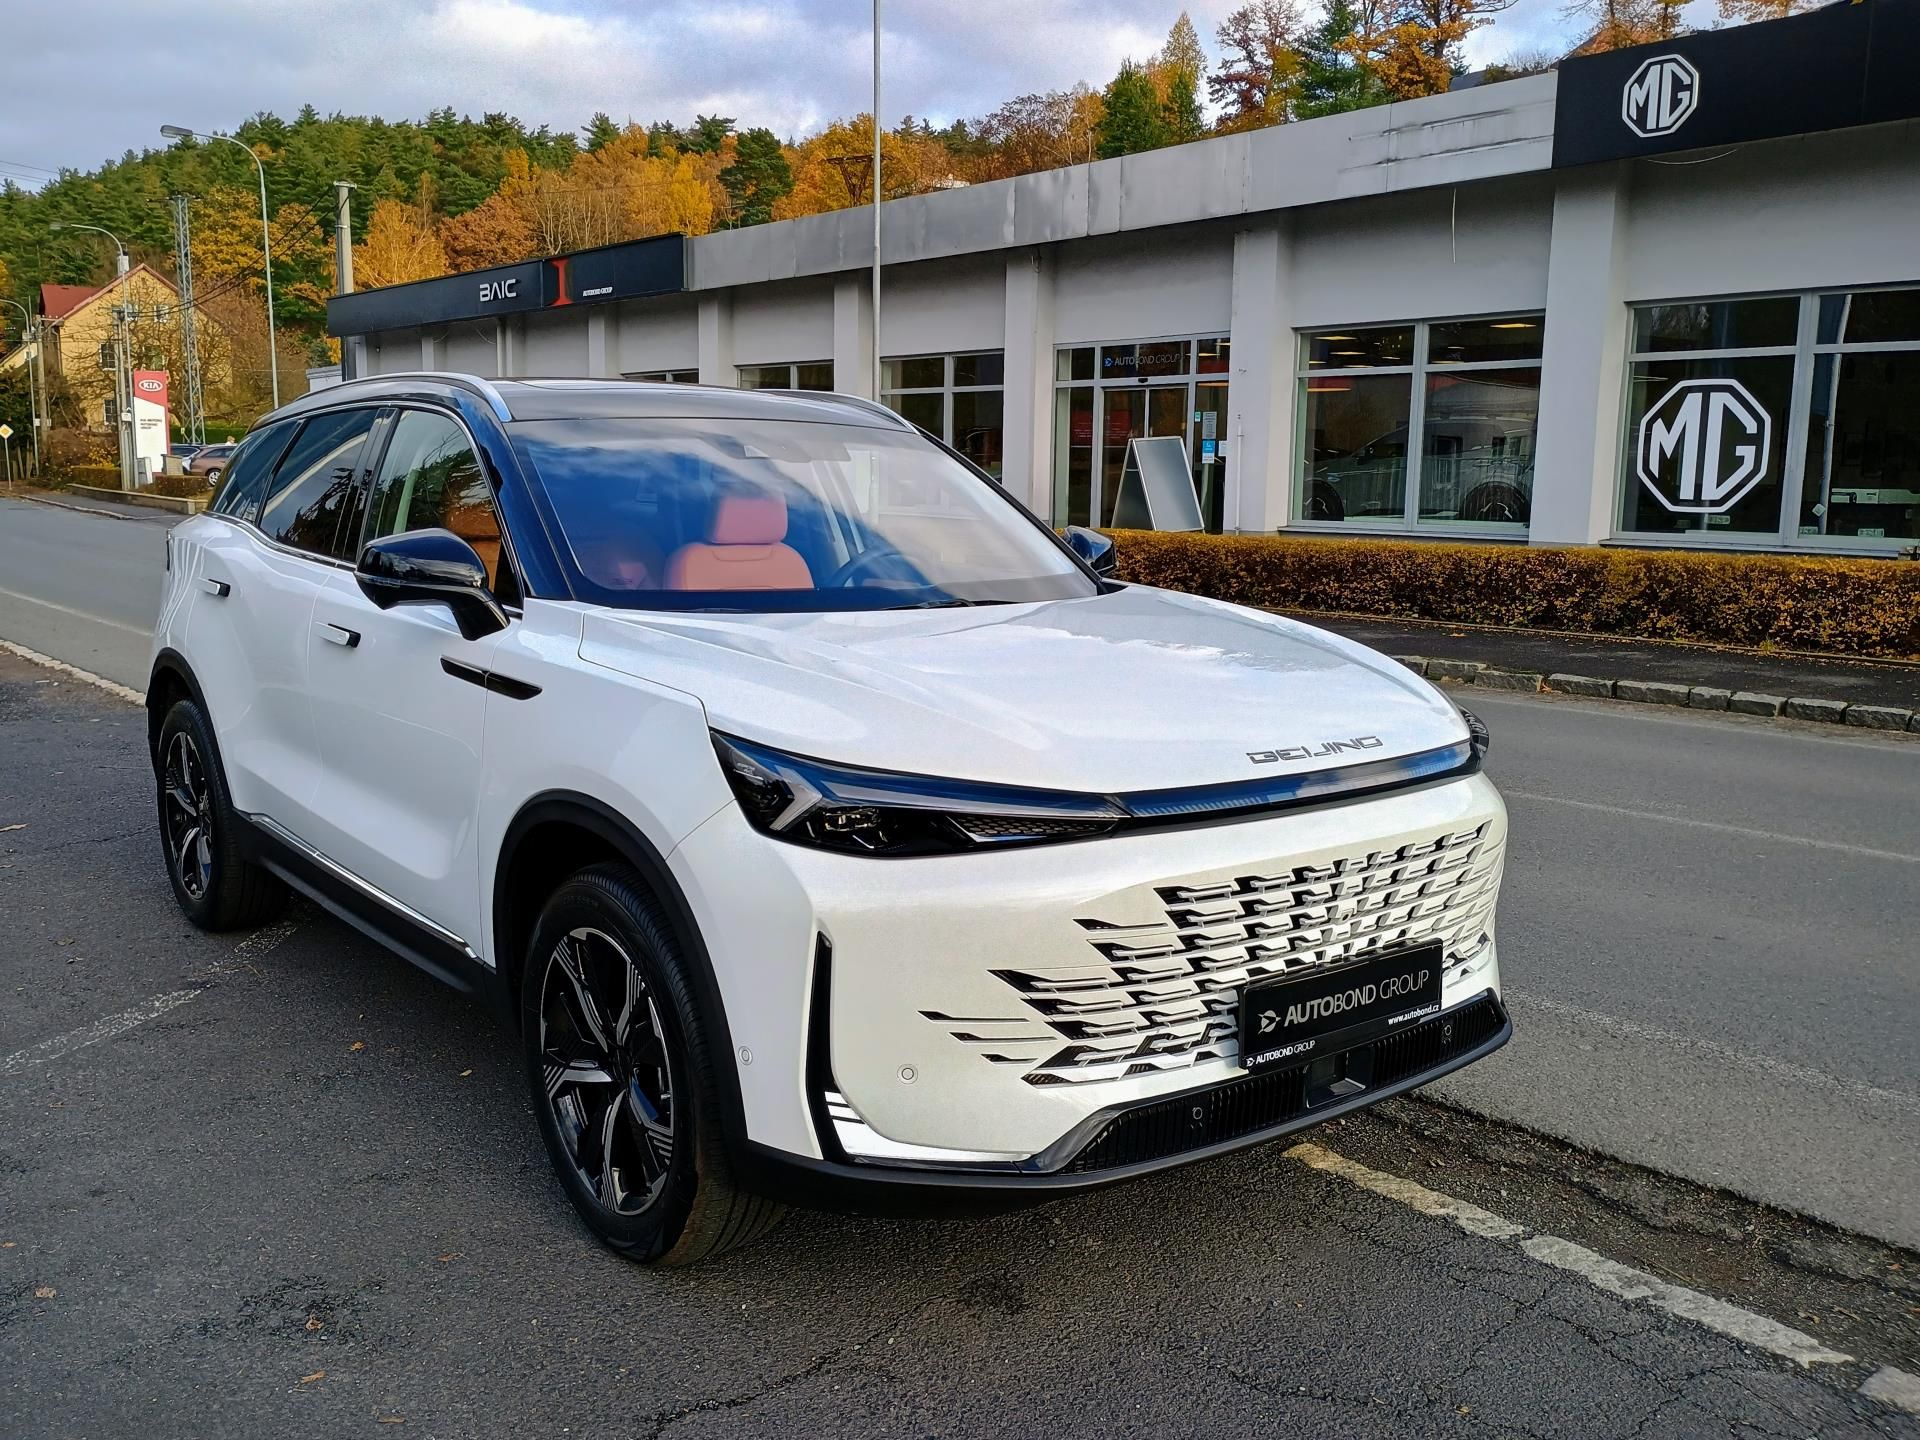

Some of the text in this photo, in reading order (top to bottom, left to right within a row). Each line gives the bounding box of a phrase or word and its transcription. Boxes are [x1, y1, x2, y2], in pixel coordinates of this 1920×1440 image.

[1629, 62, 1691, 130] MG
[479, 278, 517, 302] BAIC
[1649, 391, 1758, 501] MG
[1246, 735, 1384, 764] BEIJING
[1284, 969, 1430, 1027] AUTOBOND GROUP
[1388, 1004, 1440, 1026] www.autobond.cz
[1255, 1039, 1316, 1065] AUTOBOND GROUP
